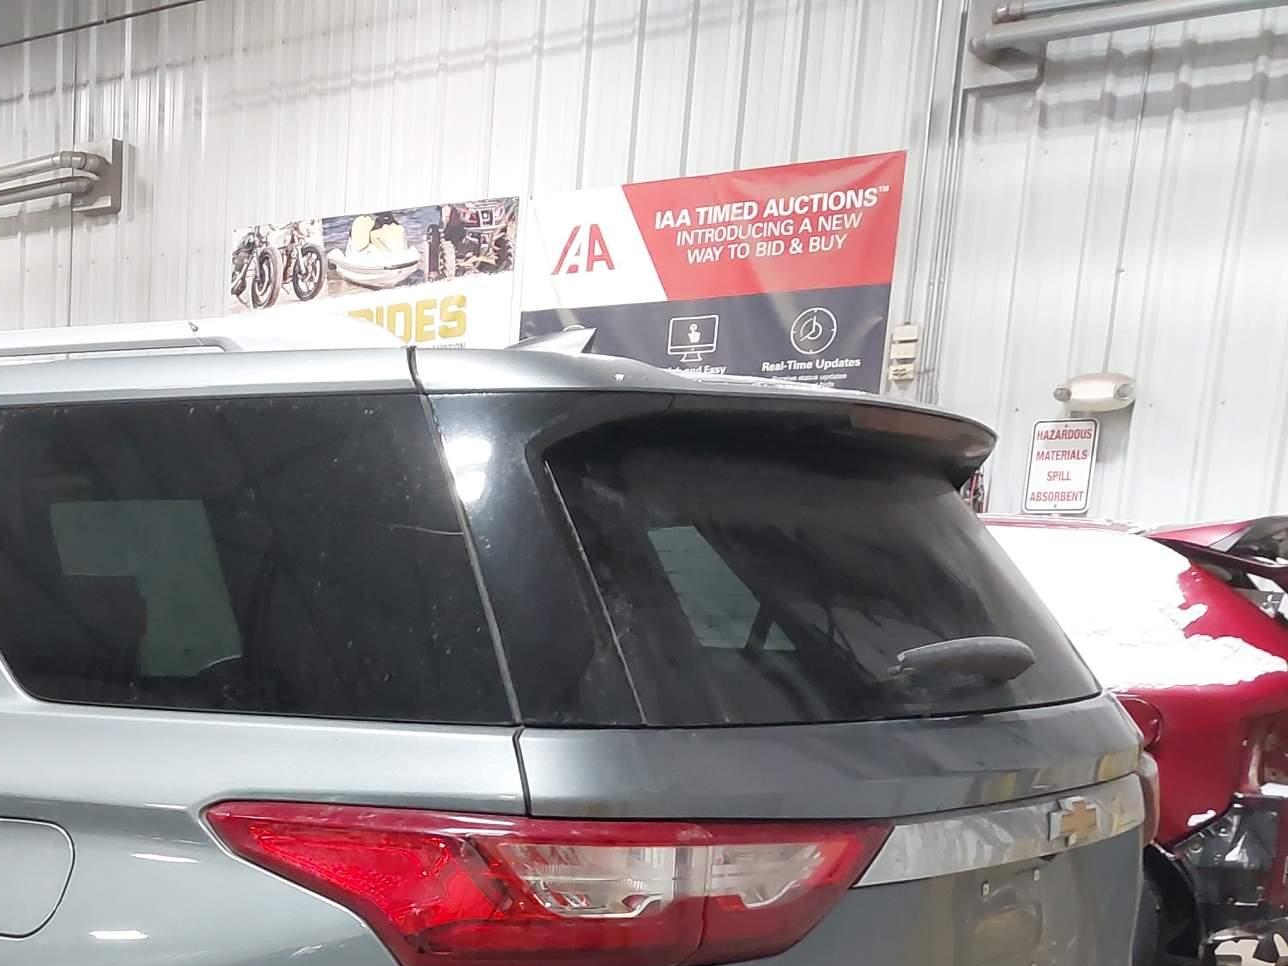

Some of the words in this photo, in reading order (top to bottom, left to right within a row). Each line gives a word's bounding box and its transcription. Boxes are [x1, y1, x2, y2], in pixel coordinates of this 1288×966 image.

[654, 209, 692, 230] IAA
[695, 201, 759, 226] TIMED
[676, 219, 794, 246] INTRODUCING
[798, 217, 813, 234] A
[817, 211, 863, 232] NEW
[686, 246, 724, 265] WAY
[727, 242, 751, 260] TO
[755, 239, 785, 257] BID
[788, 237, 804, 256] &
[808, 234, 848, 252] BUY
[703, 365, 728, 375] Easy
[761, 360, 813, 372] Real-Time
[815, 358, 862, 371] Updates
[1036, 428, 1093, 441] HAZARDOUS
[1035, 449, 1089, 461] MATERIALS
[1046, 470, 1072, 482] SPILL
[1029, 490, 1085, 502] ABSORBENT
